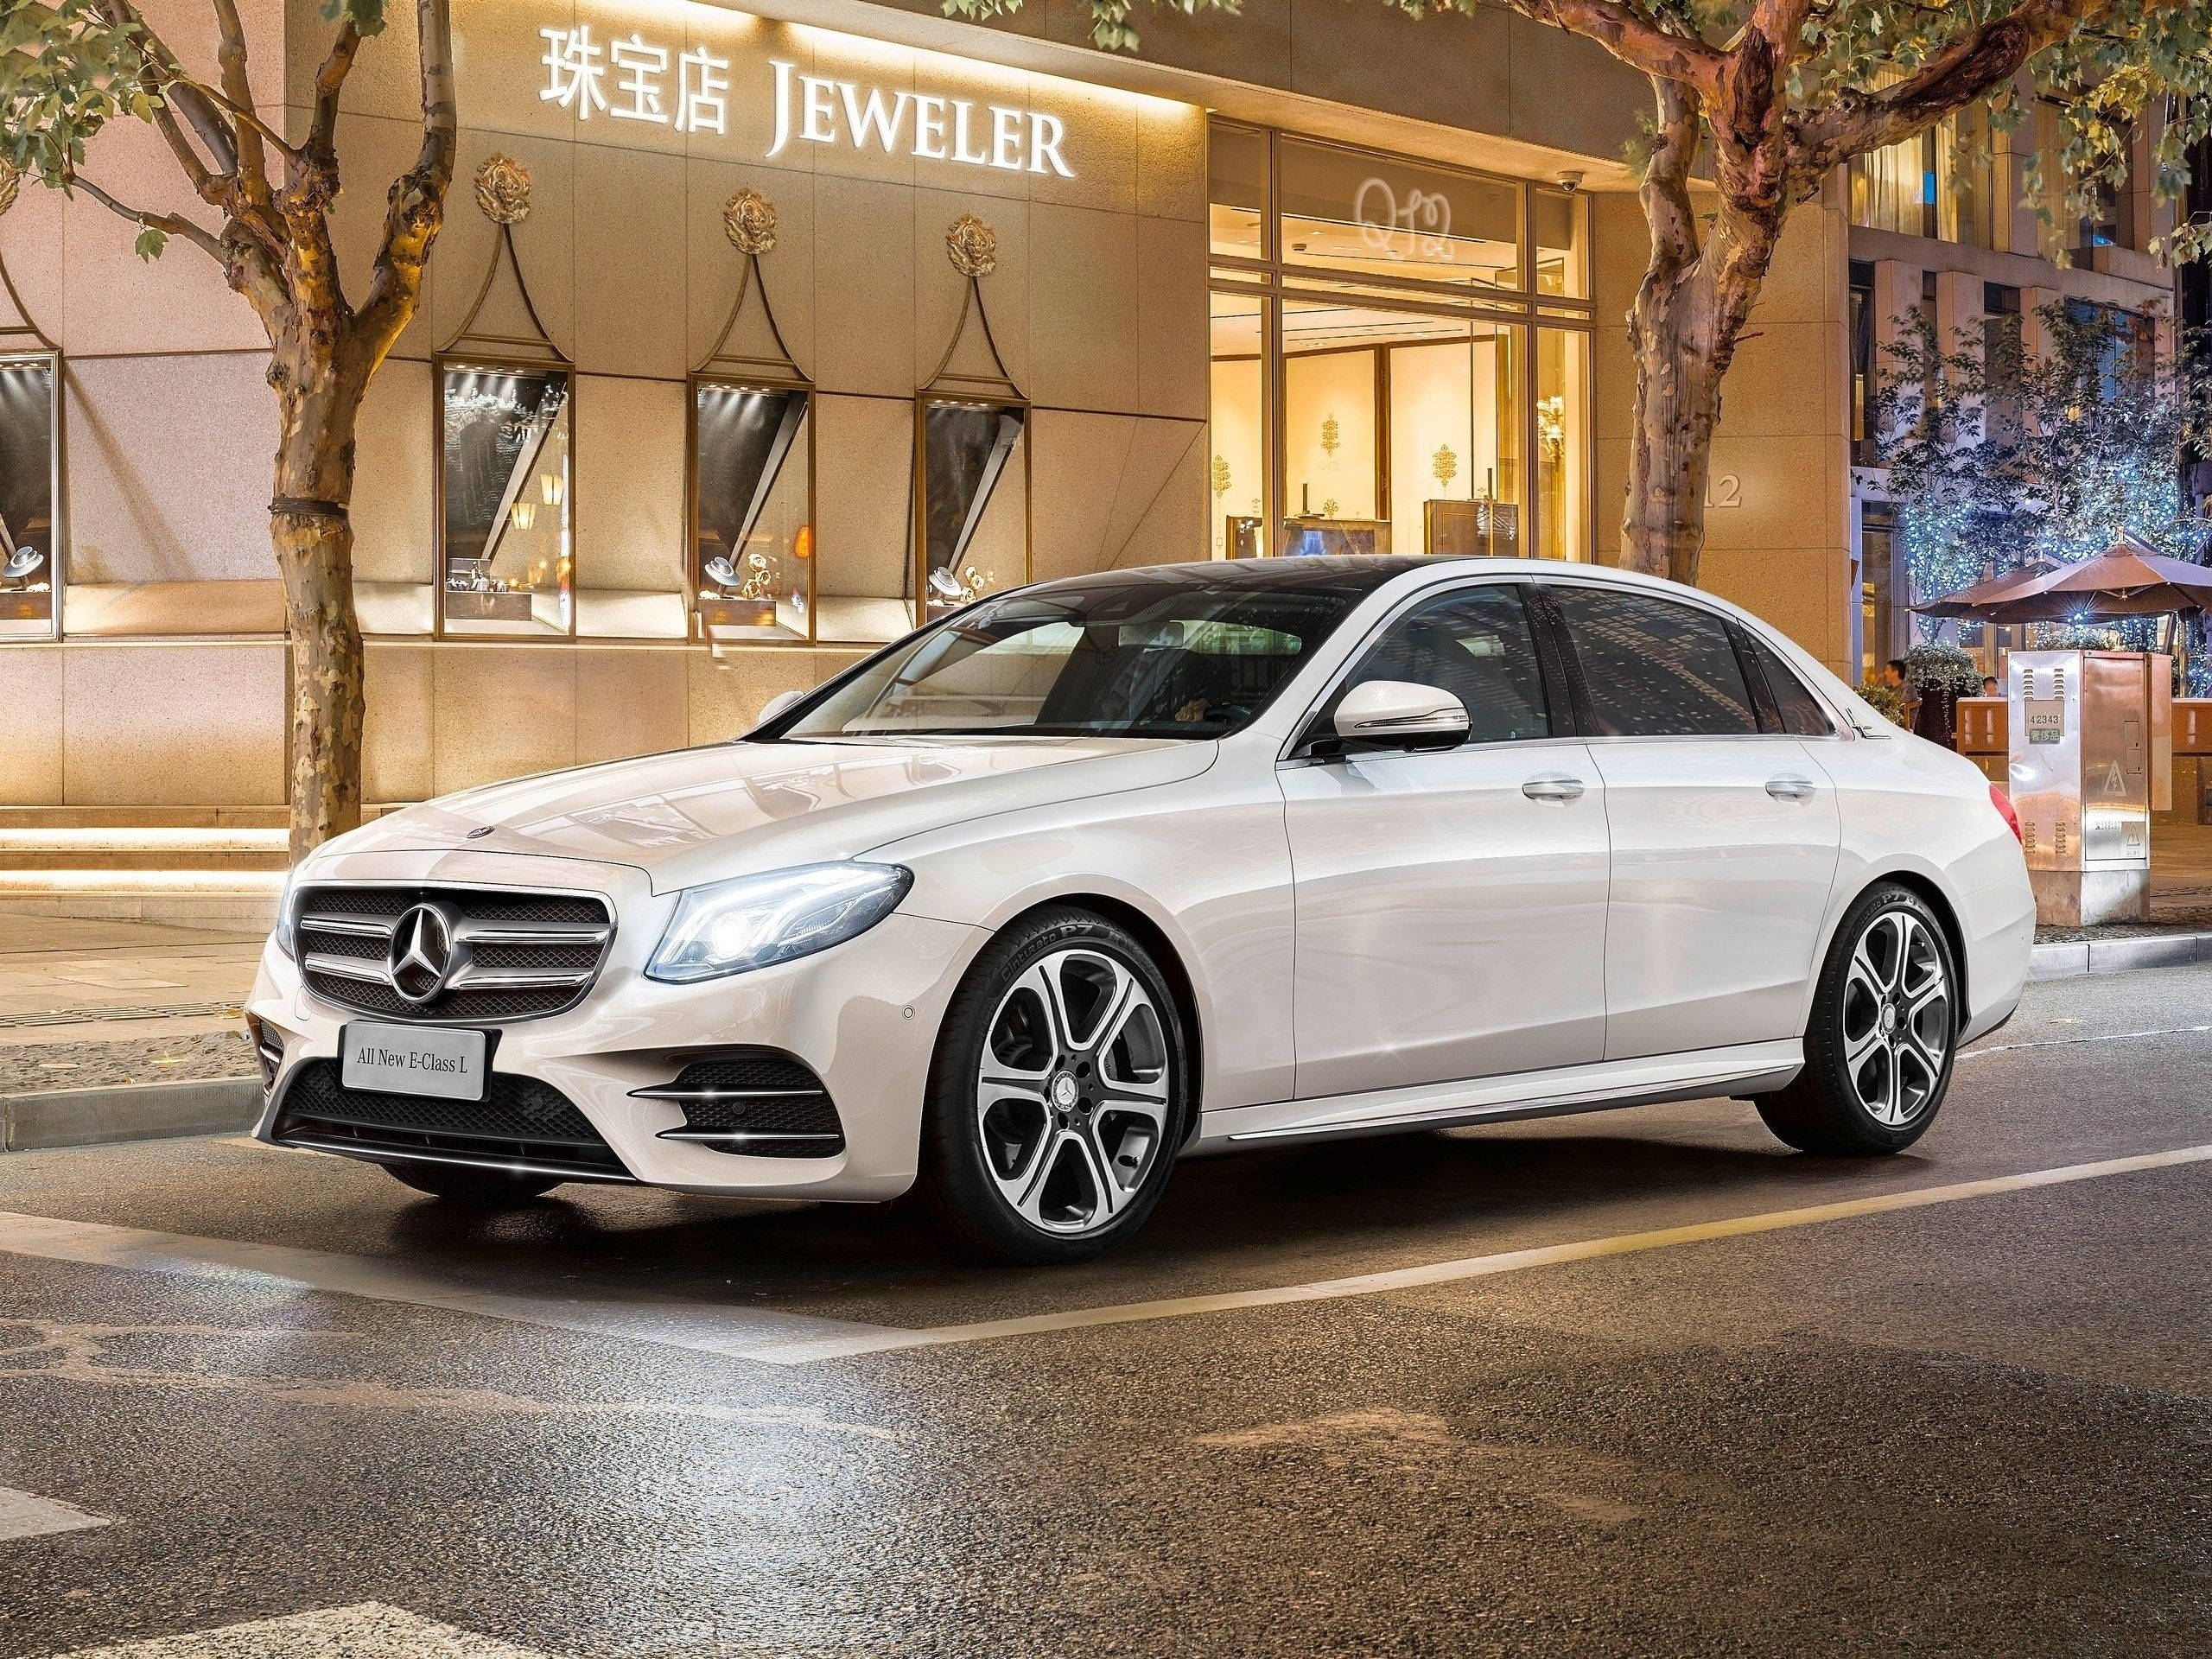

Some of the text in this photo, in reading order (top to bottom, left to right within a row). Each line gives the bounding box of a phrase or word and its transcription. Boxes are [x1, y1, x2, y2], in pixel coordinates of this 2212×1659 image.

[539, 24, 728, 136] 珠宝店
[765, 60, 1076, 178] JEWELER
[2030, 715, 2058, 724] 42343
[2031, 729, 2059, 741] 奢侈品
[1060, 925, 1093, 938] P7
[357, 1047, 468, 1073] All New E-Class L
